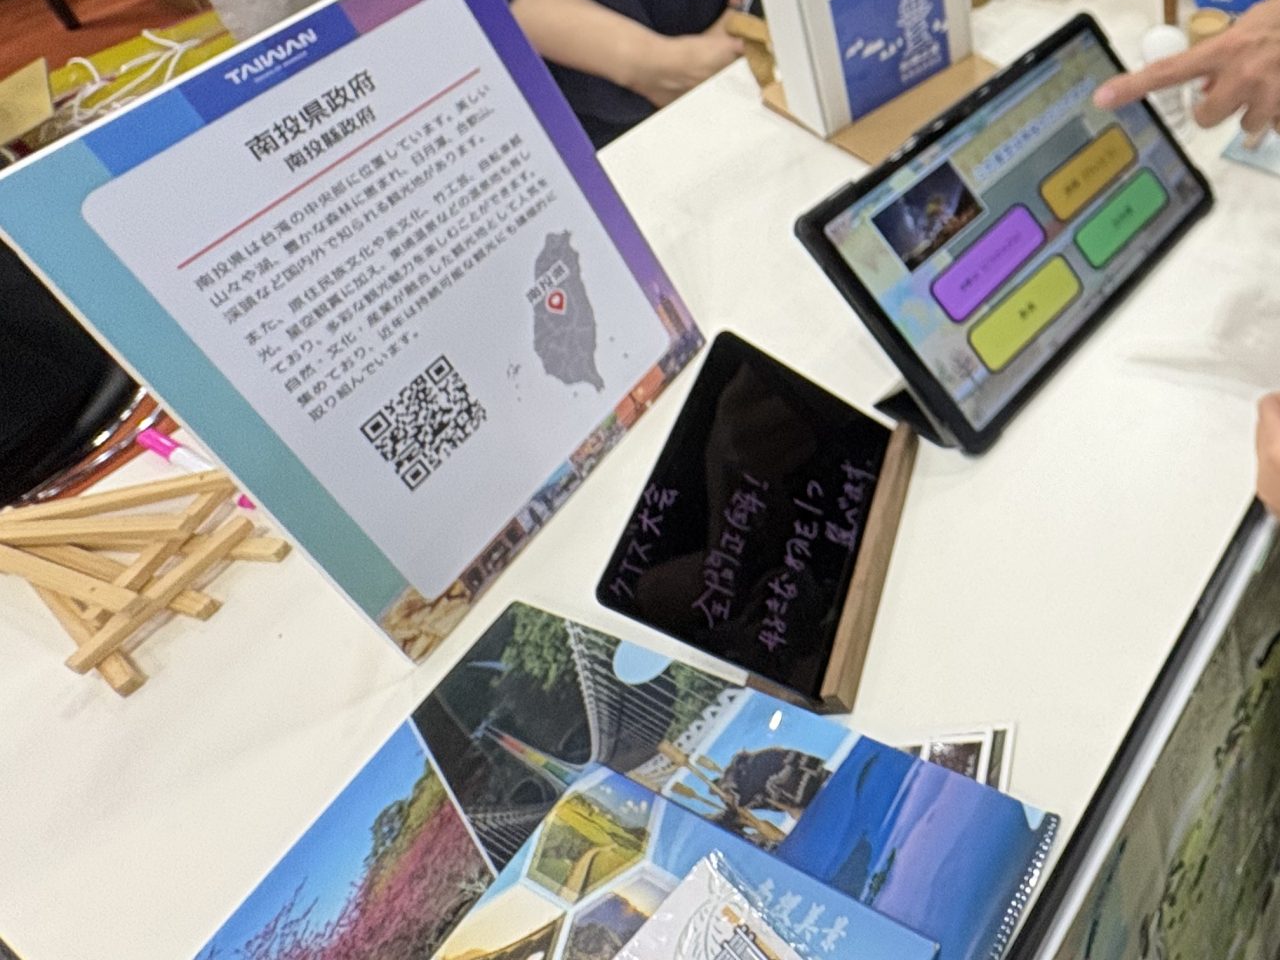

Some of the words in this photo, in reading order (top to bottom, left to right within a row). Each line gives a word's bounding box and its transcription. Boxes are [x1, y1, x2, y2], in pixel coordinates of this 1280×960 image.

[224, 27, 319, 86] TAIWAN
[242, 68, 378, 161] 南投県政府
[306, 324, 420, 423] 取り組んでいます。
